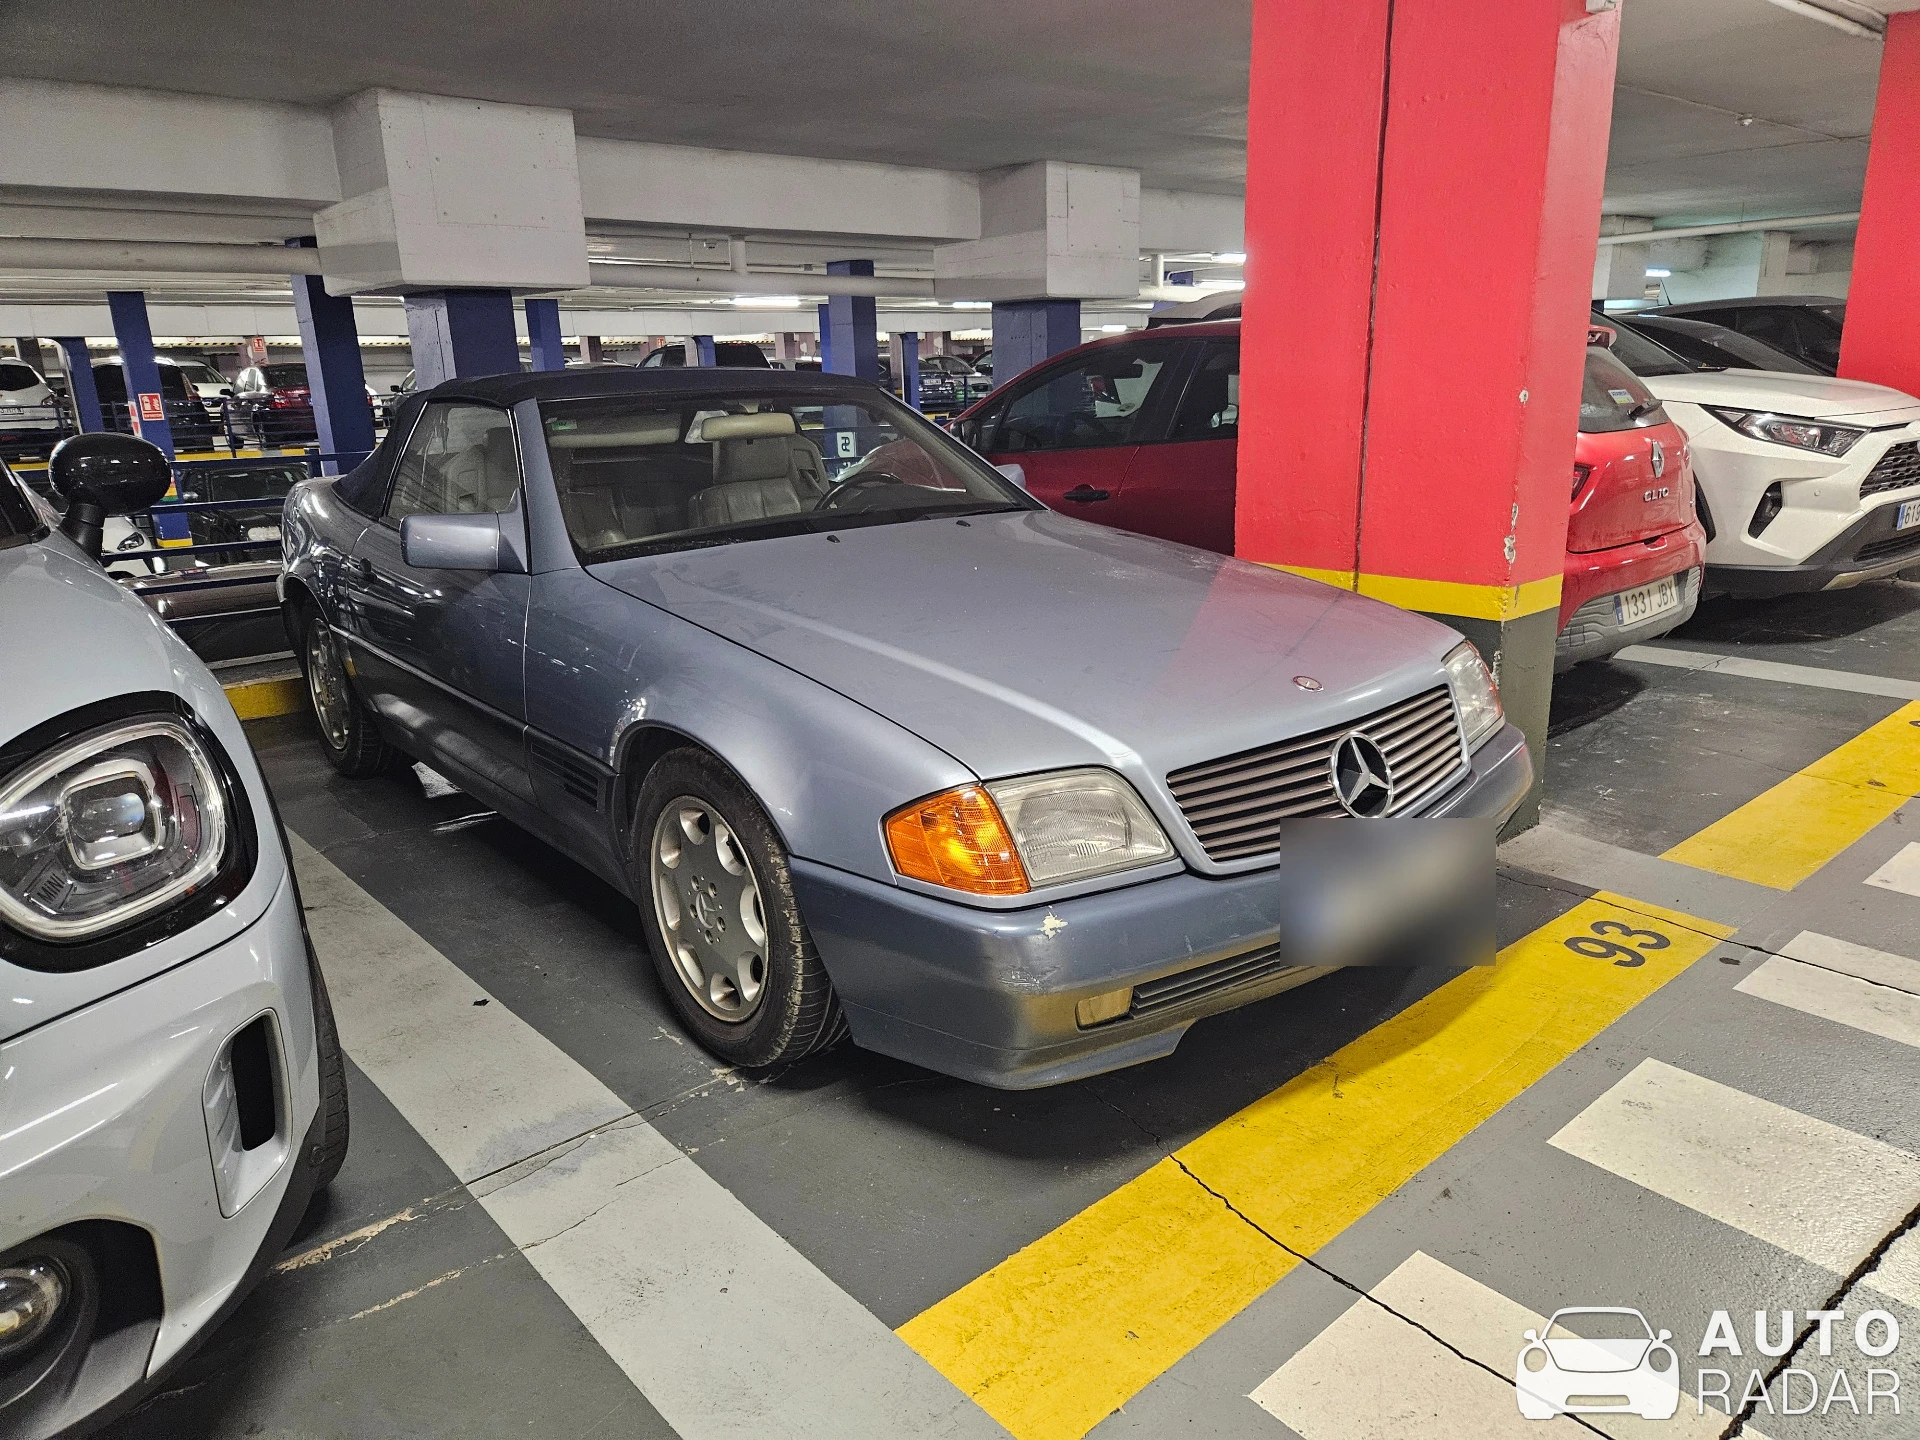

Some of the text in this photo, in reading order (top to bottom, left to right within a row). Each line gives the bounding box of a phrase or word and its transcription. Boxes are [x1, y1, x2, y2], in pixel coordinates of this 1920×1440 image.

[1643, 487, 1669, 502] CLIO
[1625, 581, 1675, 619] 1331 JBX
[37, 873, 65, 904] MINI
[1564, 921, 1671, 968] 93
